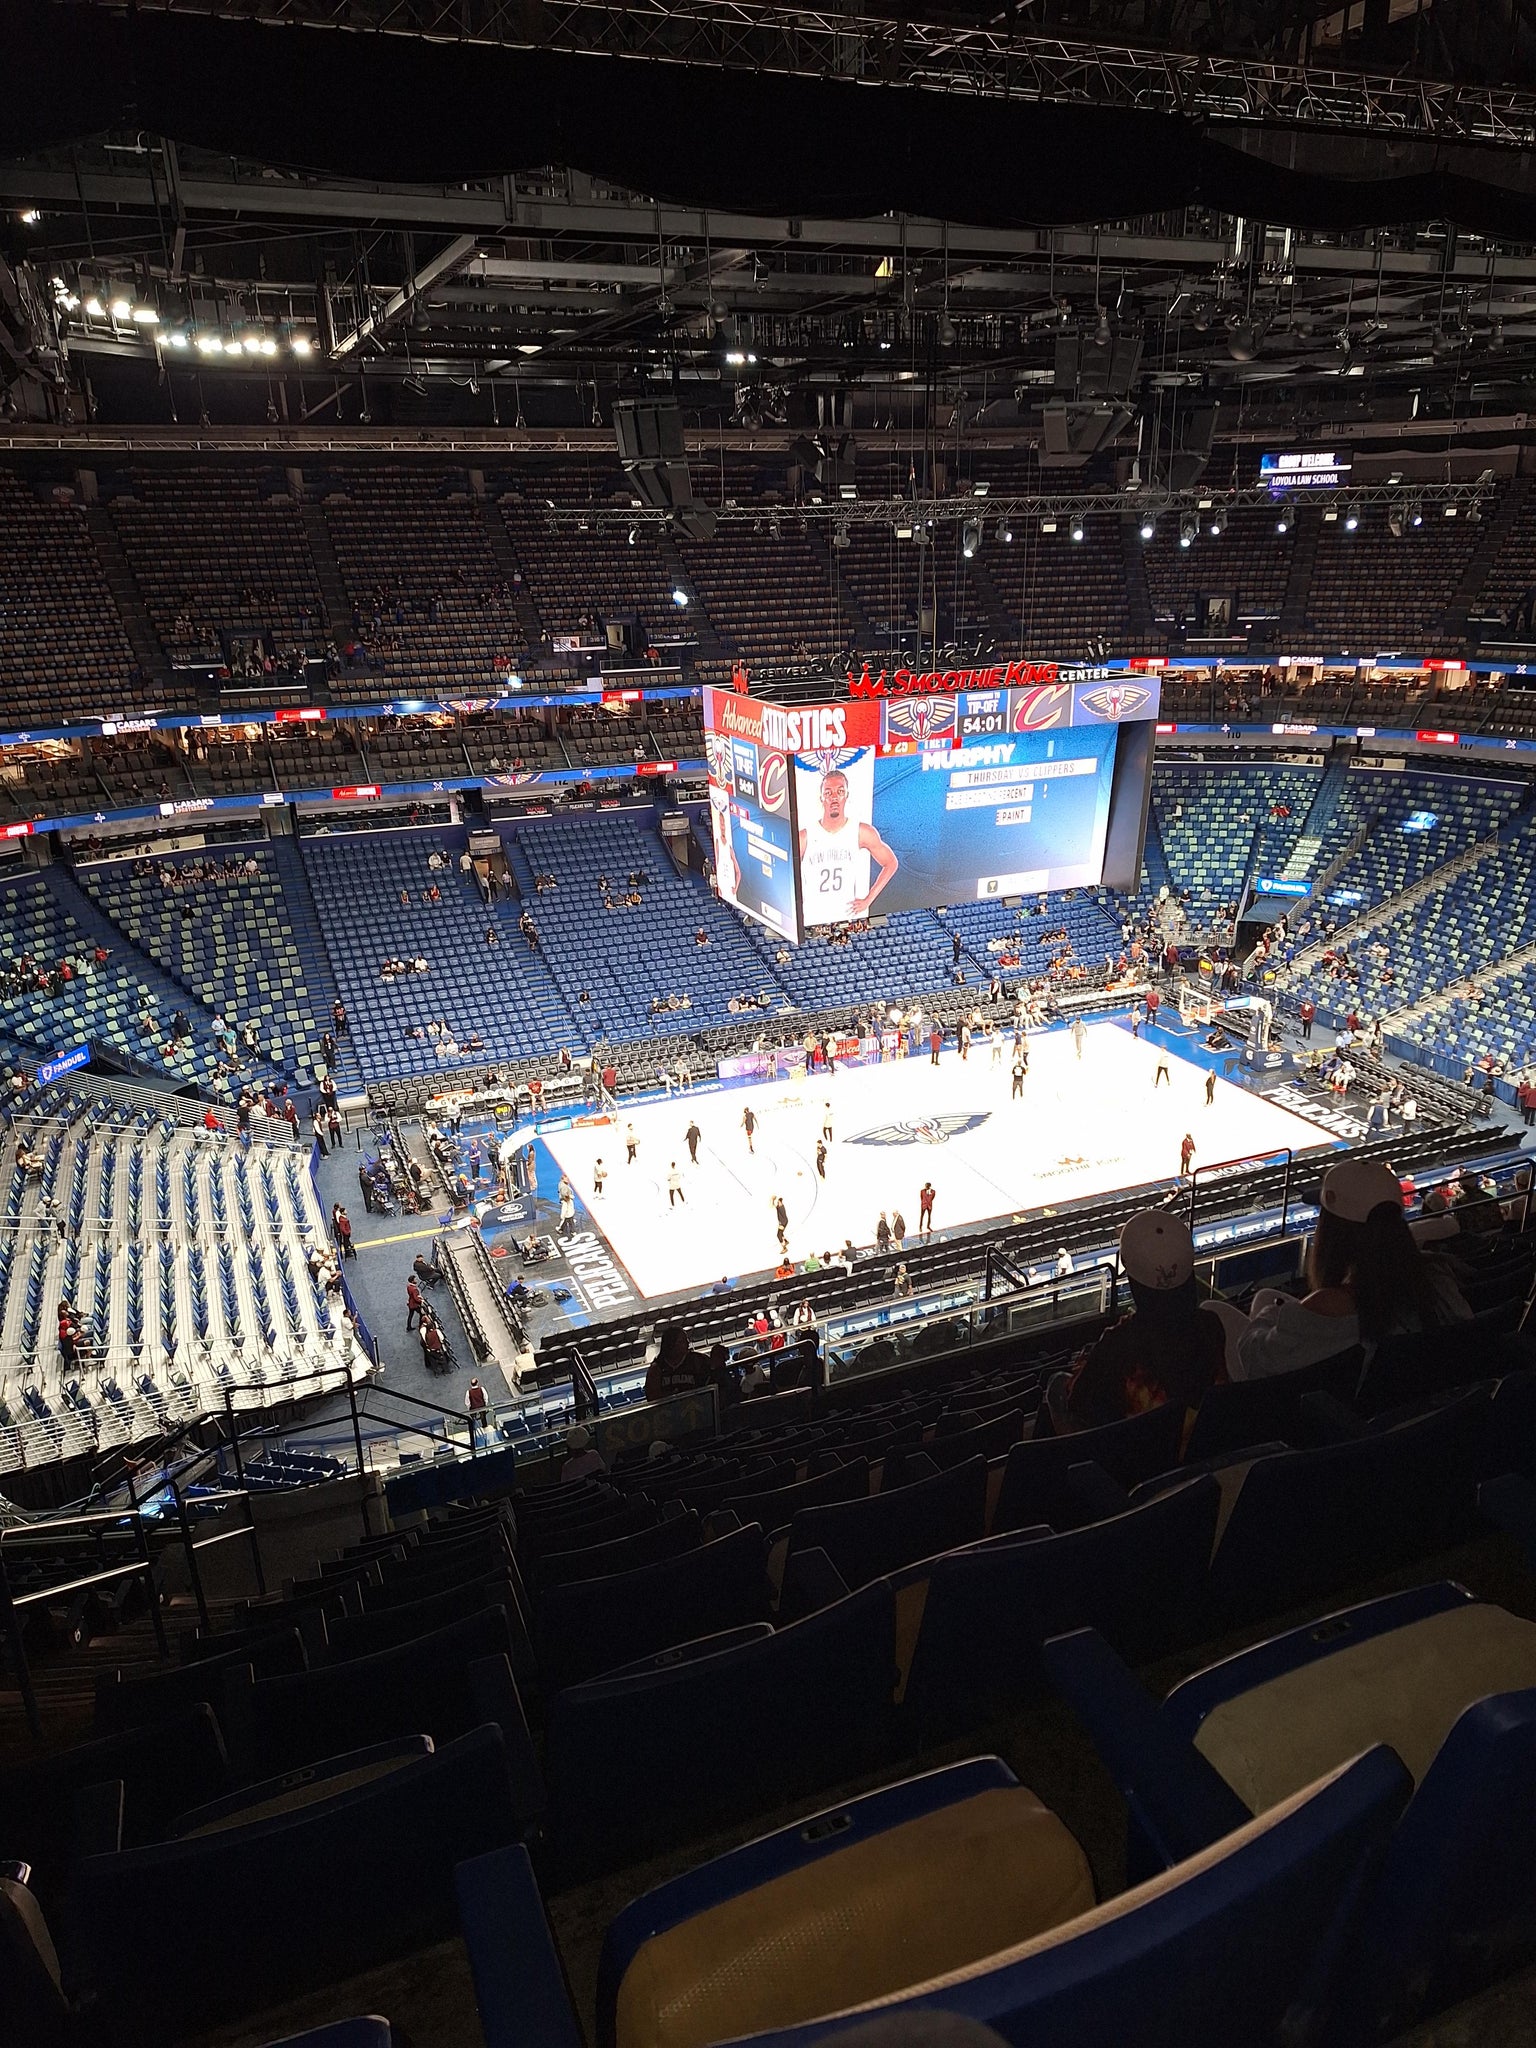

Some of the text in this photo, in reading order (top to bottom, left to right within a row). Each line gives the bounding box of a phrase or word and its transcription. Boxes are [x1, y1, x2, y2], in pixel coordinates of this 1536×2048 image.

[1302, 453, 1335, 467] WELCOME
[1272, 474, 1339, 486] LOYOLA LAW SCHOOL
[1292, 656, 1324, 664] CAESARS
[891, 667, 1003, 696] SMOOTHIE
[1059, 668, 1110, 682] CENTER
[968, 700, 999, 714] TIP-OFF
[117, 719, 158, 730] CAESARS
[722, 700, 846, 751] Advanced STATISTICS
[963, 714, 1002, 733] 54:01
[1285, 724, 1318, 732] CAESARS
[922, 744, 1016, 771] MURPHY
[968, 762, 1075, 784] THURSDAY VS CLIPPERS
[174, 798, 215, 809] CAESARS
[1002, 809, 1024, 821] PAINT
[819, 867, 843, 893] 25
[53, 1052, 86, 1073] FANDUEL
[1259, 1087, 1369, 1138] PELICANS
[1212, 1160, 1266, 1177] MORRIS
[557, 1232, 635, 1310] PELICANS
